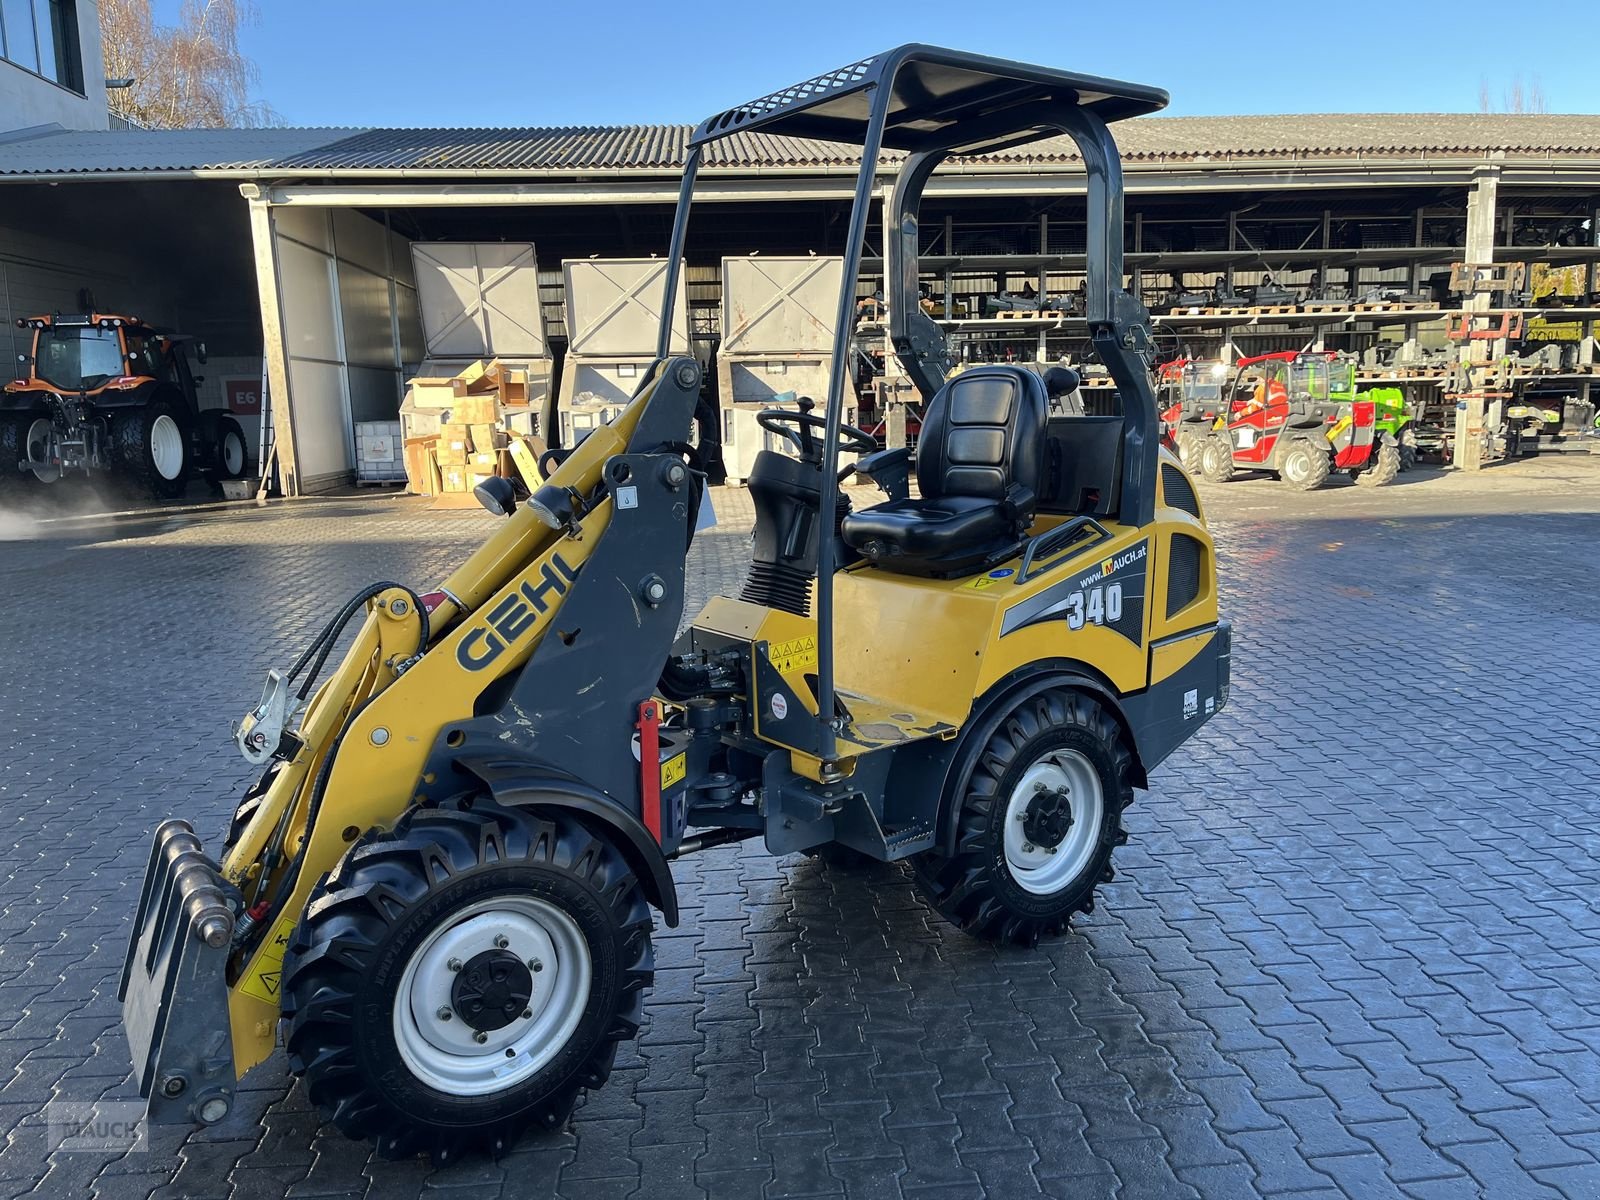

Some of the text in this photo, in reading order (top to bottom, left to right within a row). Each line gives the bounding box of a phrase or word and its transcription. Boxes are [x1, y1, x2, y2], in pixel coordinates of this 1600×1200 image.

[235, 391, 256, 404] E6
[1080, 545, 1147, 588] www.MAUCH.at
[455, 551, 584, 672] GEHL
[1067, 582, 1122, 631] 340
